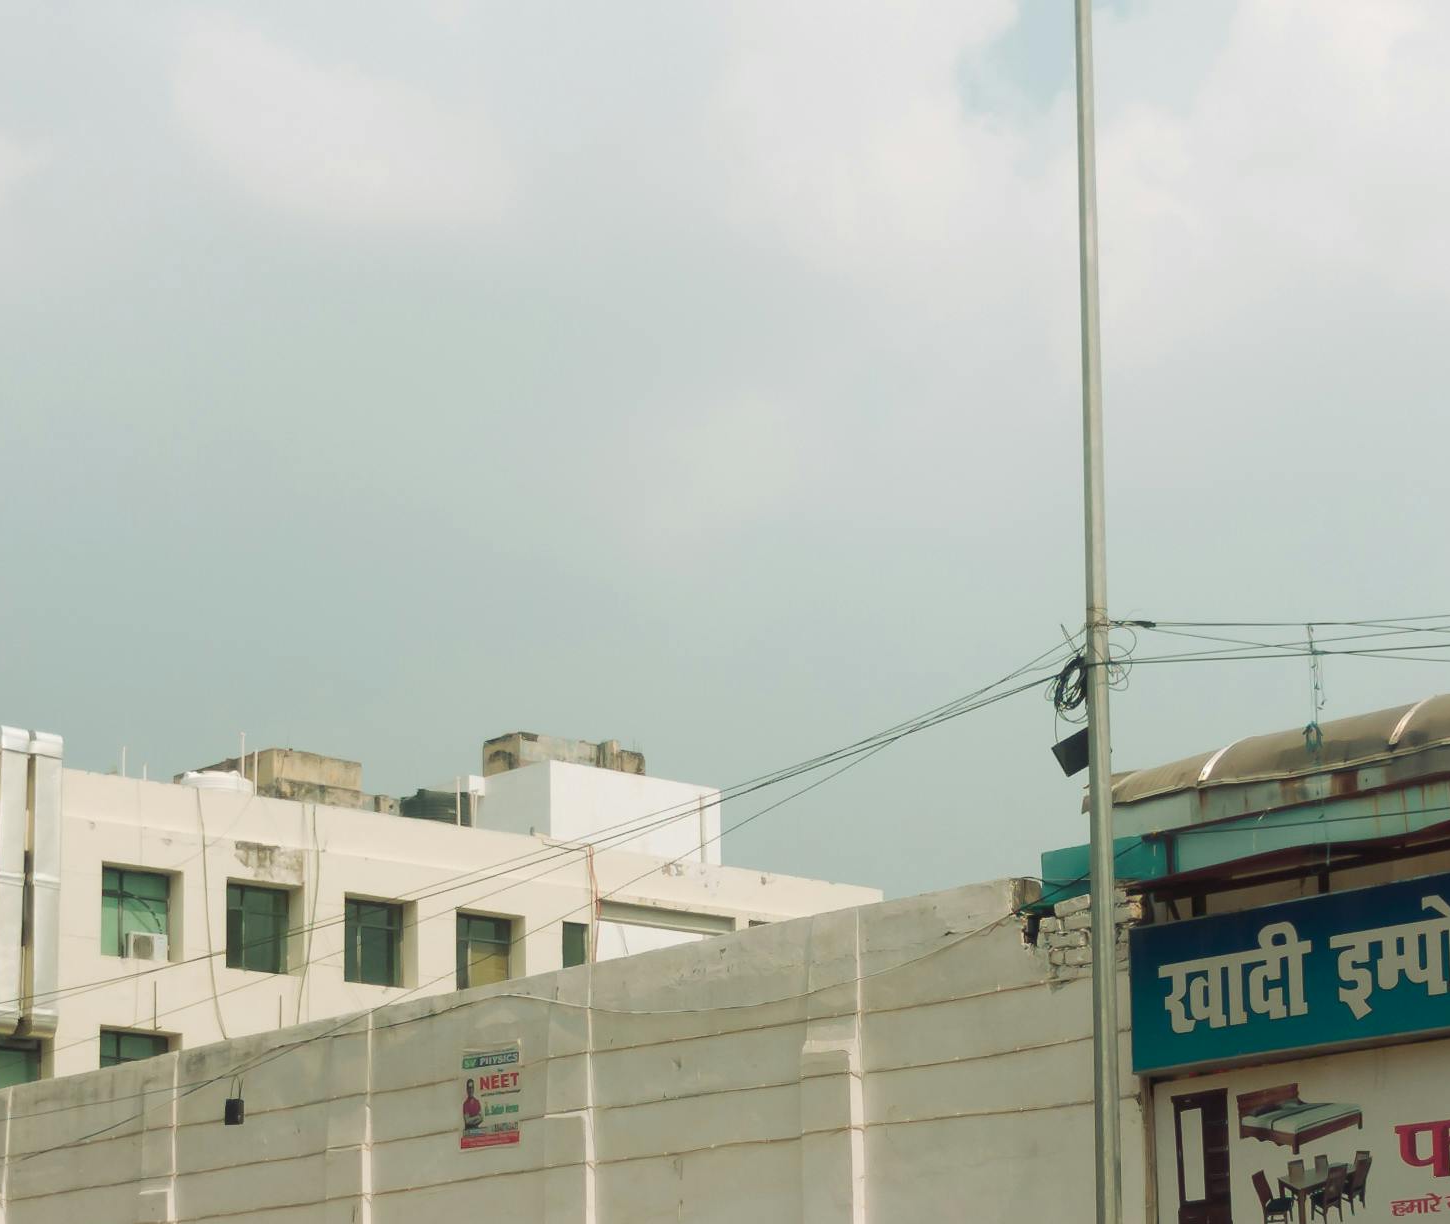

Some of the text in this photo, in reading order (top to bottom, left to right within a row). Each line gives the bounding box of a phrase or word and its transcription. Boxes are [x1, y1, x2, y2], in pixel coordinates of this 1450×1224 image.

[1158, 921, 1312, 1033] खादी
[479, 1052, 518, 1066] PHYSICS
[480, 1072, 520, 1090] NEET
[1391, 1189, 1442, 1218] हमारे
